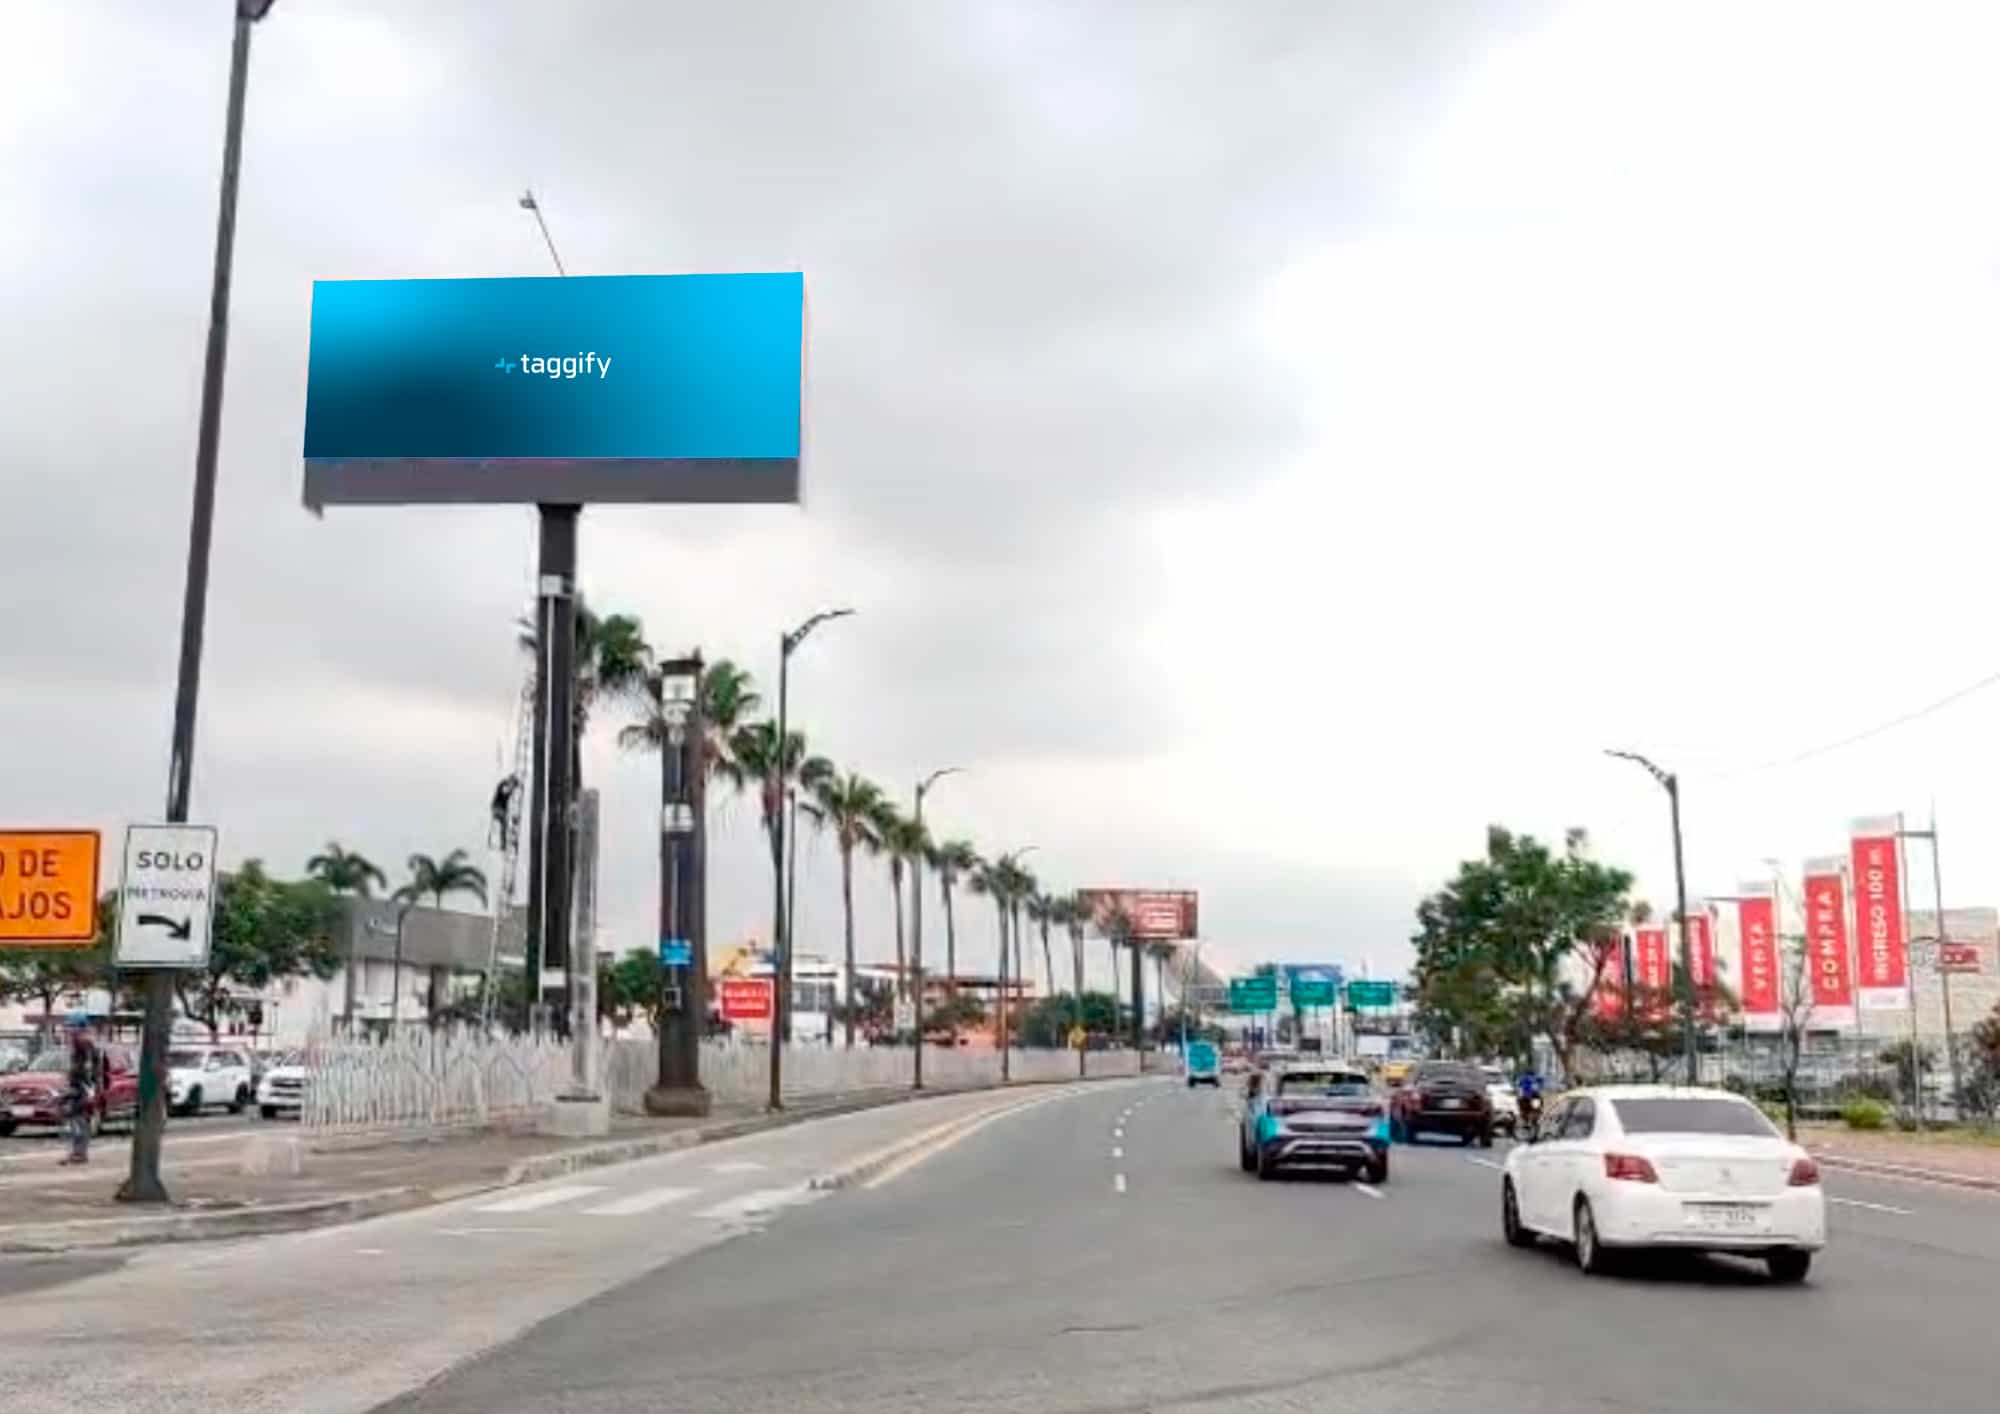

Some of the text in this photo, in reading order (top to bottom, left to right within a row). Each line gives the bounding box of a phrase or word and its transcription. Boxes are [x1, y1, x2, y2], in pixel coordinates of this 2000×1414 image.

[520, 351, 612, 379] taggify
[19, 849, 60, 877] DE
[136, 851, 204, 871] SOLO
[0, 890, 71, 920] JOS
[1816, 890, 1840, 991] COMPRA
[1751, 922, 1769, 991] VENTA
